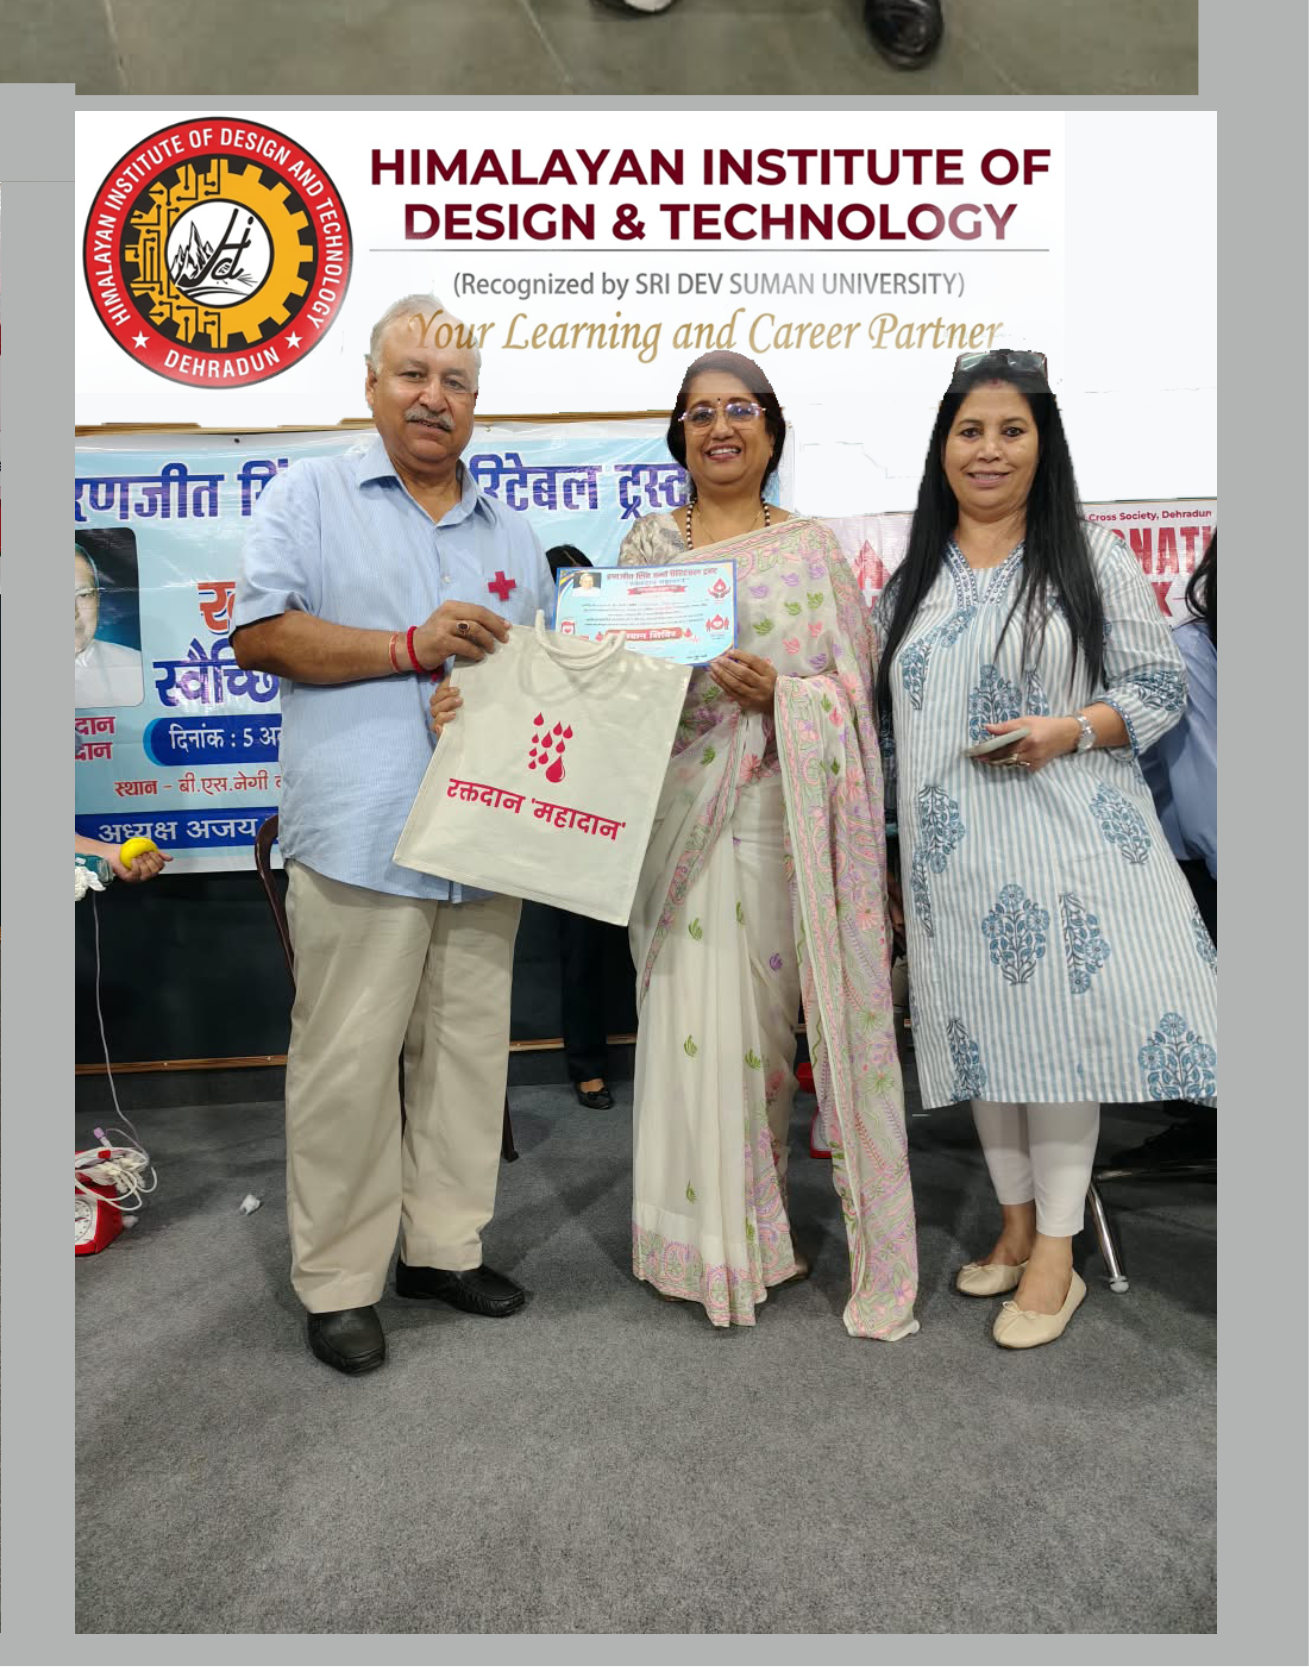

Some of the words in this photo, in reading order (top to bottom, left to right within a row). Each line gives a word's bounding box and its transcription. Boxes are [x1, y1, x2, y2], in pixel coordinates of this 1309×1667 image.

[1088, 513, 1117, 522] Cross
[1120, 510, 1160, 521] Society,
[1161, 509, 1212, 520] Dehradun
[169, 723, 225, 753] दिनांक
[243, 728, 254, 747] 5
[114, 780, 158, 797] स्थान
[446, 778, 526, 814] रक्तदान
[186, 818, 258, 839] अजय
